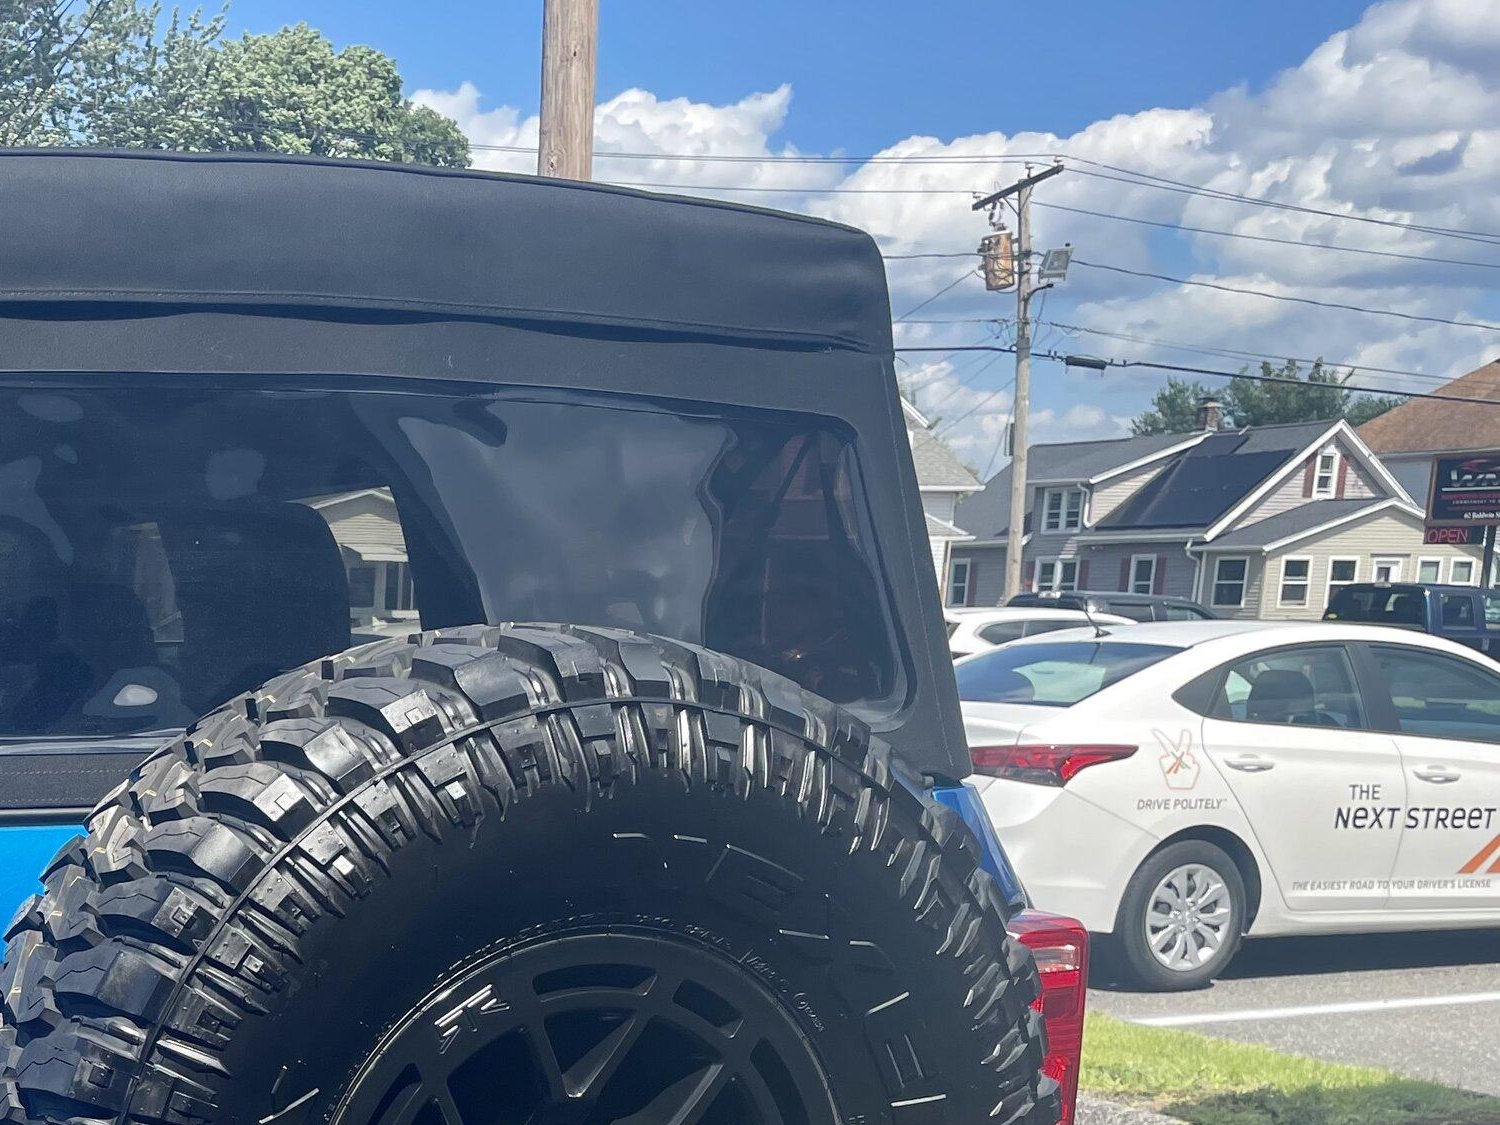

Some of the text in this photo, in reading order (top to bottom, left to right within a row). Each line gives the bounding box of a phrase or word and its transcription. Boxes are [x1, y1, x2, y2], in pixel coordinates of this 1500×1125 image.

[1427, 528, 1468, 543] OPEN
[1349, 784, 1382, 801] THE
[1137, 798, 1171, 810] DRIVE
[1291, 880, 1308, 891] THE
[1309, 880, 1348, 891] EASIEST
[1350, 880, 1375, 890] ROAD
[1377, 880, 1390, 890] TO
[1392, 880, 1415, 890] YOUR
[1417, 879, 1456, 890] DRIVER'S
